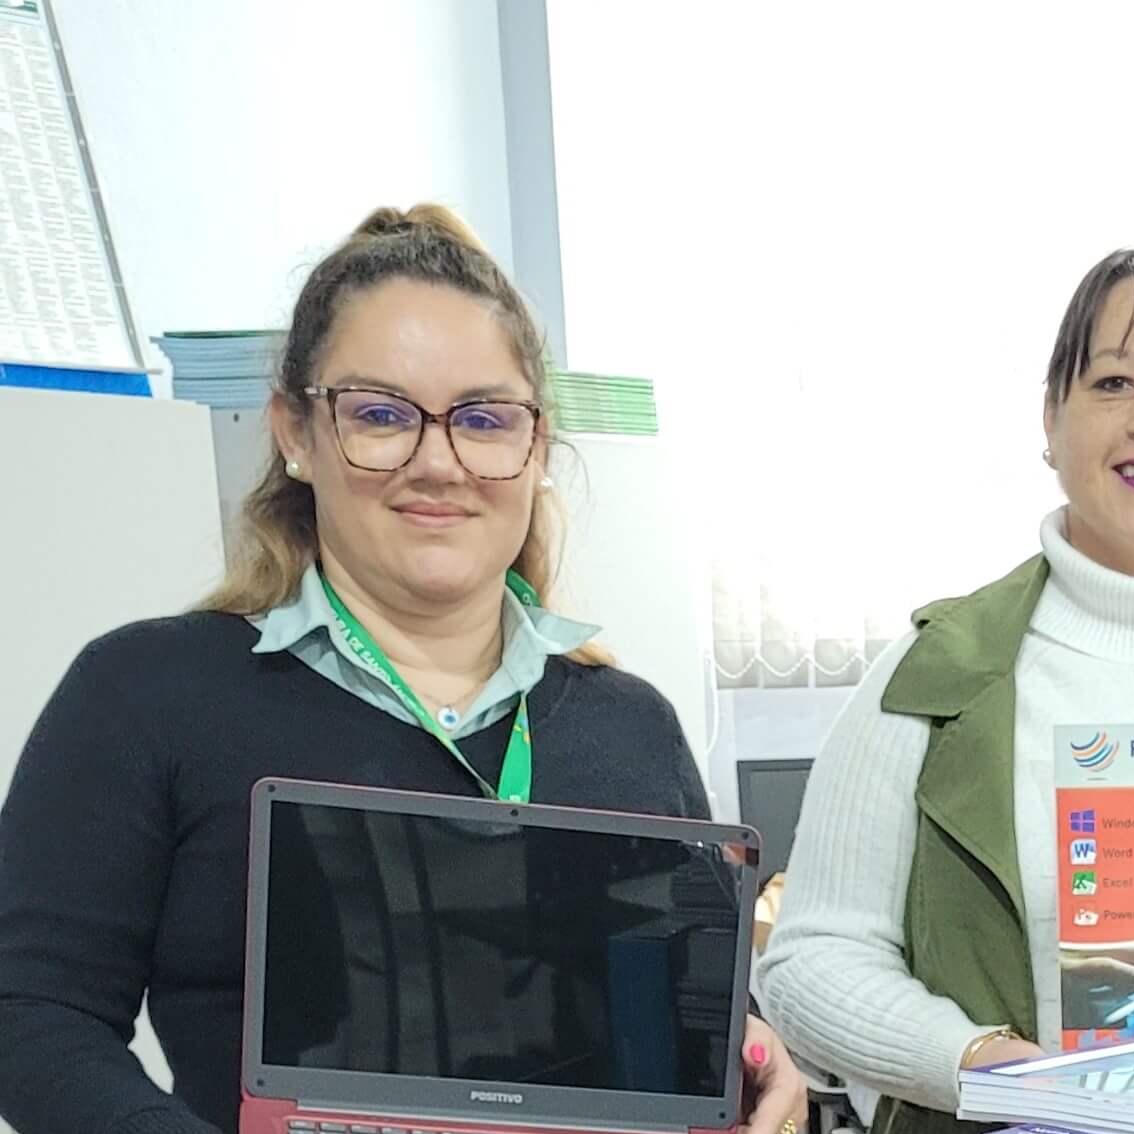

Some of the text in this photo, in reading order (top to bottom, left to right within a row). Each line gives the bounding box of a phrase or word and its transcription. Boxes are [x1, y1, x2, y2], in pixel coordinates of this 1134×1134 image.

[1103, 847, 1133, 859] Word
[1103, 877, 1133, 888] Excel
[471, 1091, 522, 1104] POSITIVO
